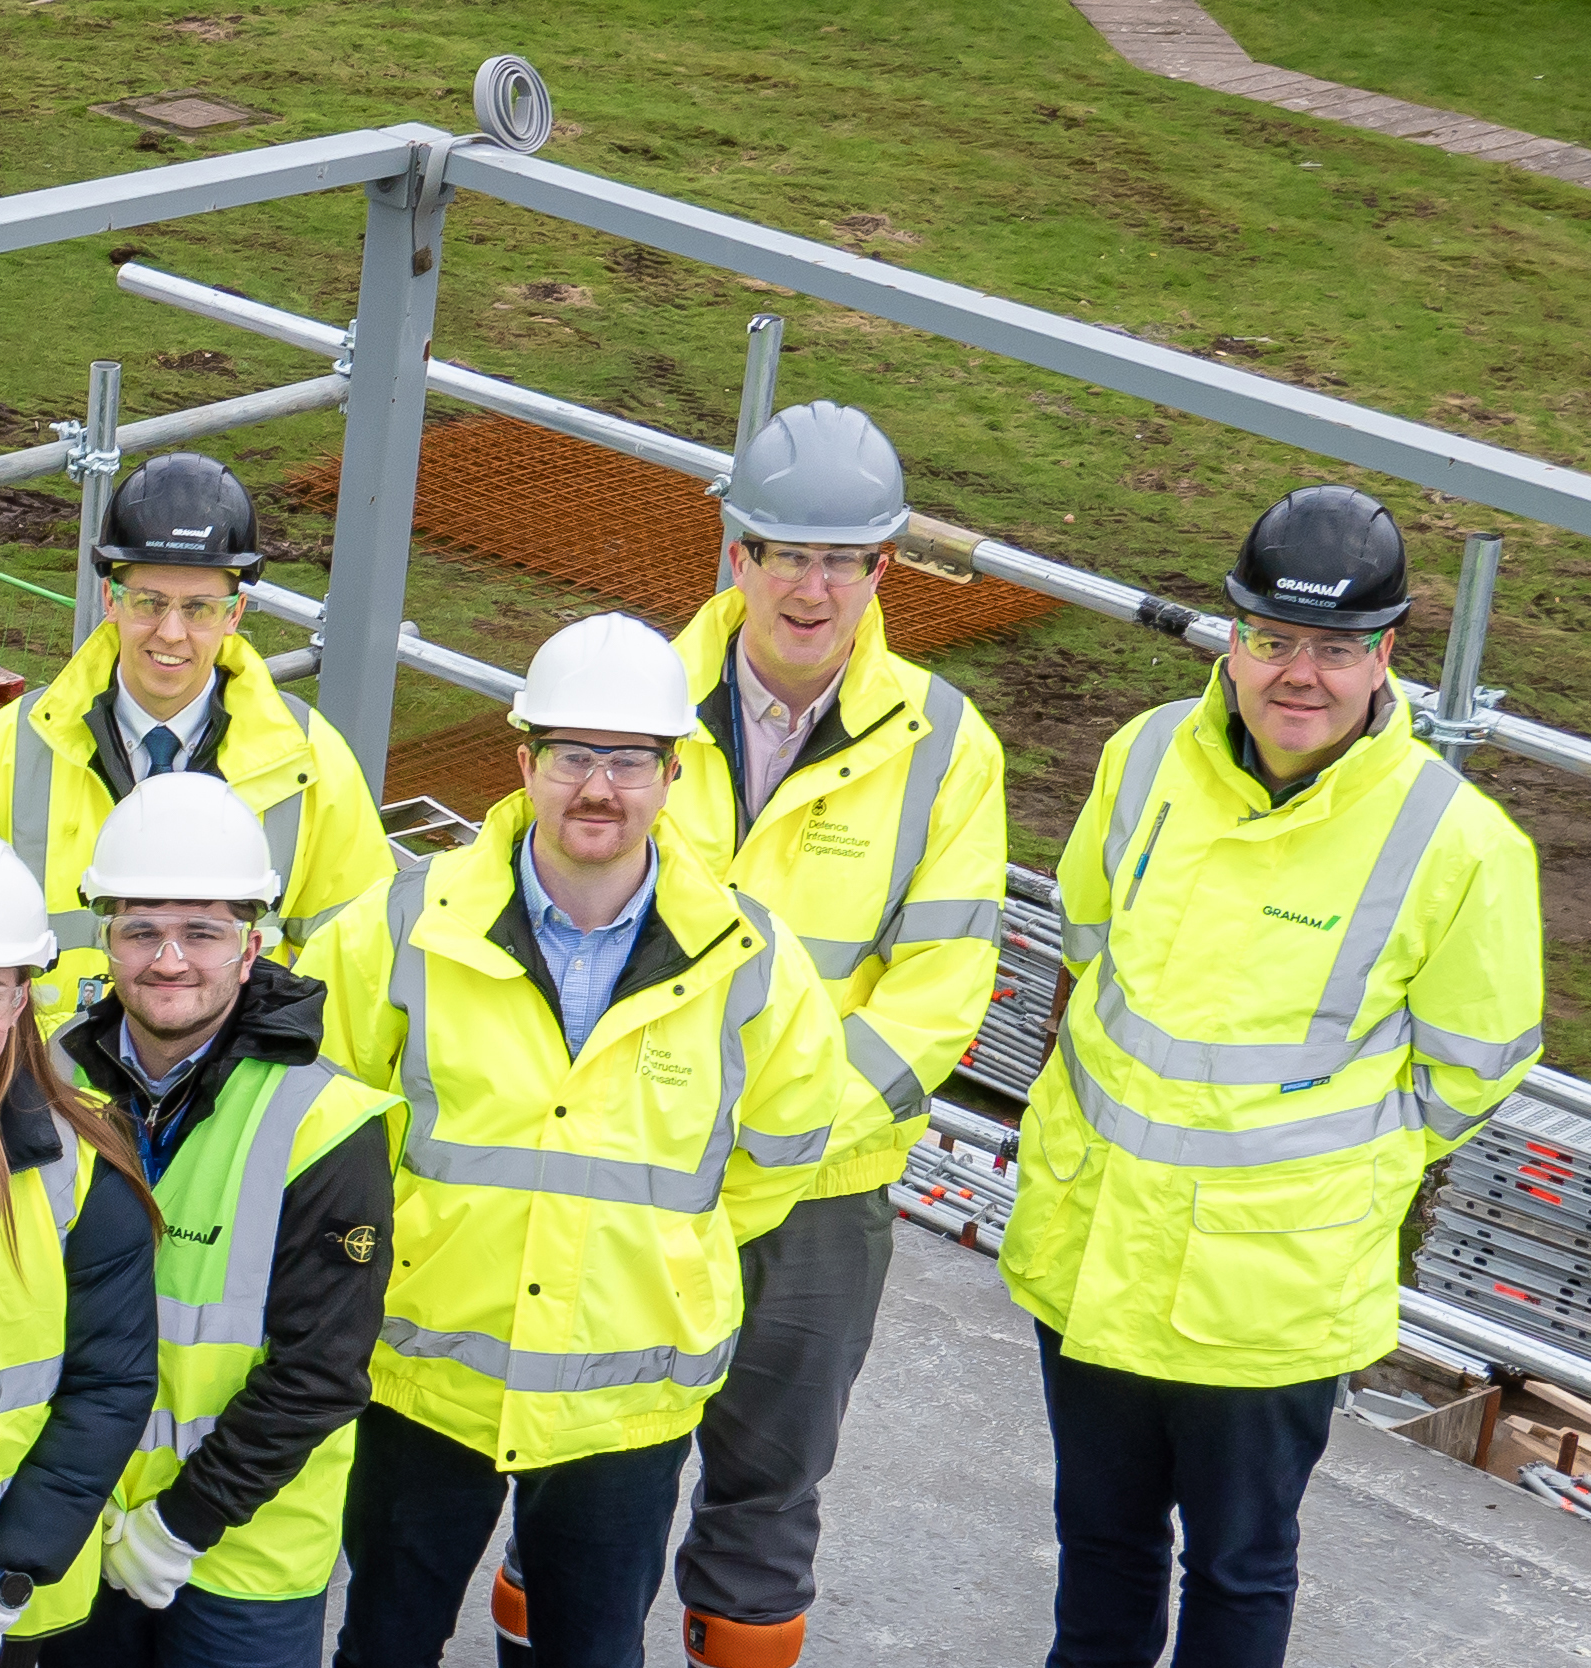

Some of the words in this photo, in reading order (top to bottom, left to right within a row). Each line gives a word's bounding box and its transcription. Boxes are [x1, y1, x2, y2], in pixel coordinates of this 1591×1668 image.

[1276, 578, 1335, 596] GRAHAM
[809, 819, 849, 832] Defence
[806, 831, 871, 847] Infrastructure
[803, 842, 866, 858] Organisation
[1262, 905, 1323, 929] GRAHAM
